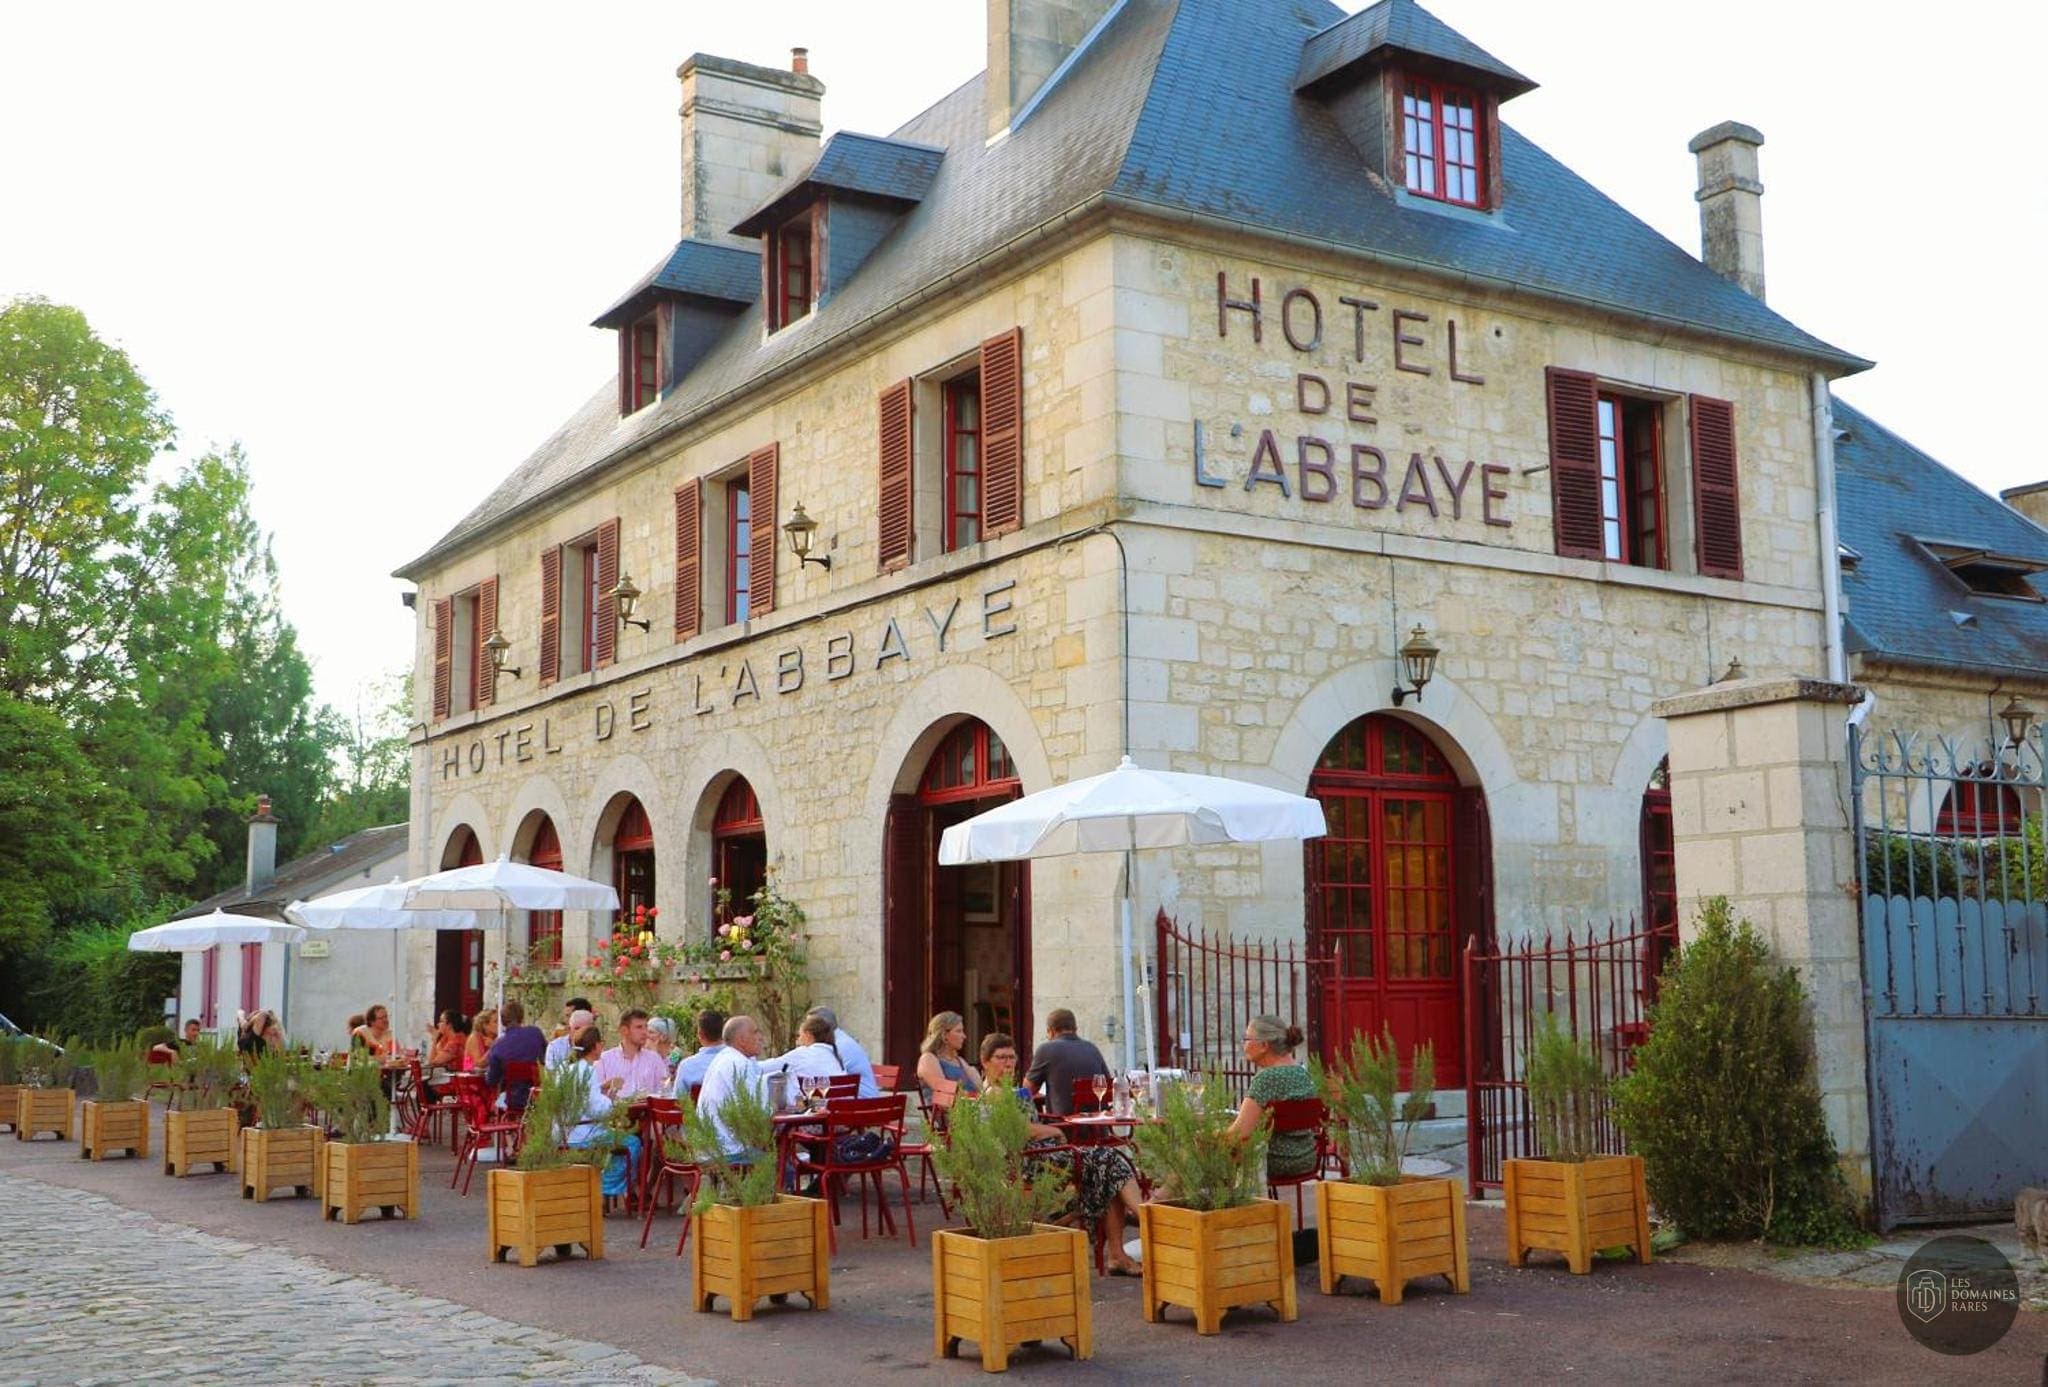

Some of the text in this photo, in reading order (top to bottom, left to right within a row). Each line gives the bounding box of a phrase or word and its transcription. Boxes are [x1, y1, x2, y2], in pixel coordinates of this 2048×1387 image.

[1217, 271, 1484, 385] HOTEL
[1298, 373, 1378, 425] DE
[1194, 418, 1513, 528] L'ABBAYE
[442, 579, 1018, 781] HOTEL DE L'ABBAYE
